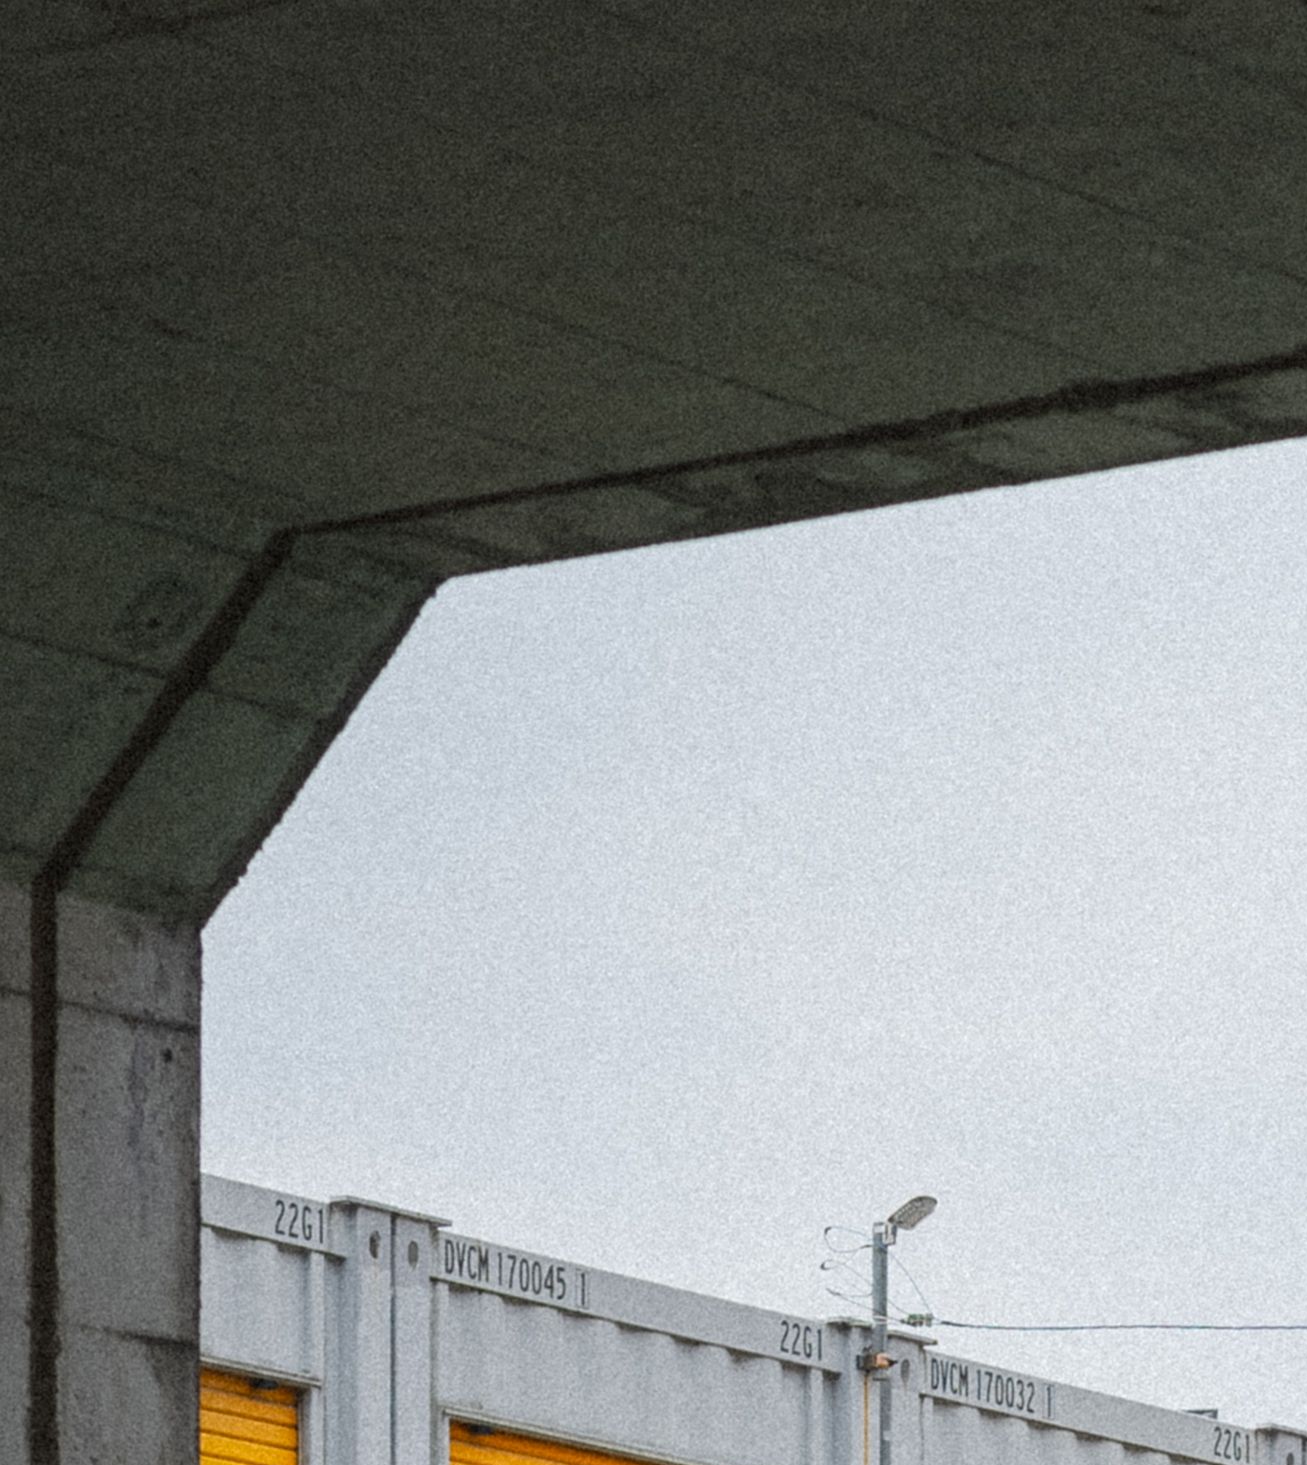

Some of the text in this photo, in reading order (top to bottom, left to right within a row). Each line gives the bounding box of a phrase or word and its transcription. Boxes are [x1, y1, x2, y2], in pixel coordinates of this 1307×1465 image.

[275, 1200, 325, 1244] 22G1
[444, 1239, 490, 1283] DVCM
[497, 1251, 566, 1300] 170045
[780, 1320, 823, 1361] 22G1
[930, 1358, 969, 1398] DVCM
[976, 1370, 1035, 1414] 170032
[1214, 1427, 1251, 1464] 22G1
